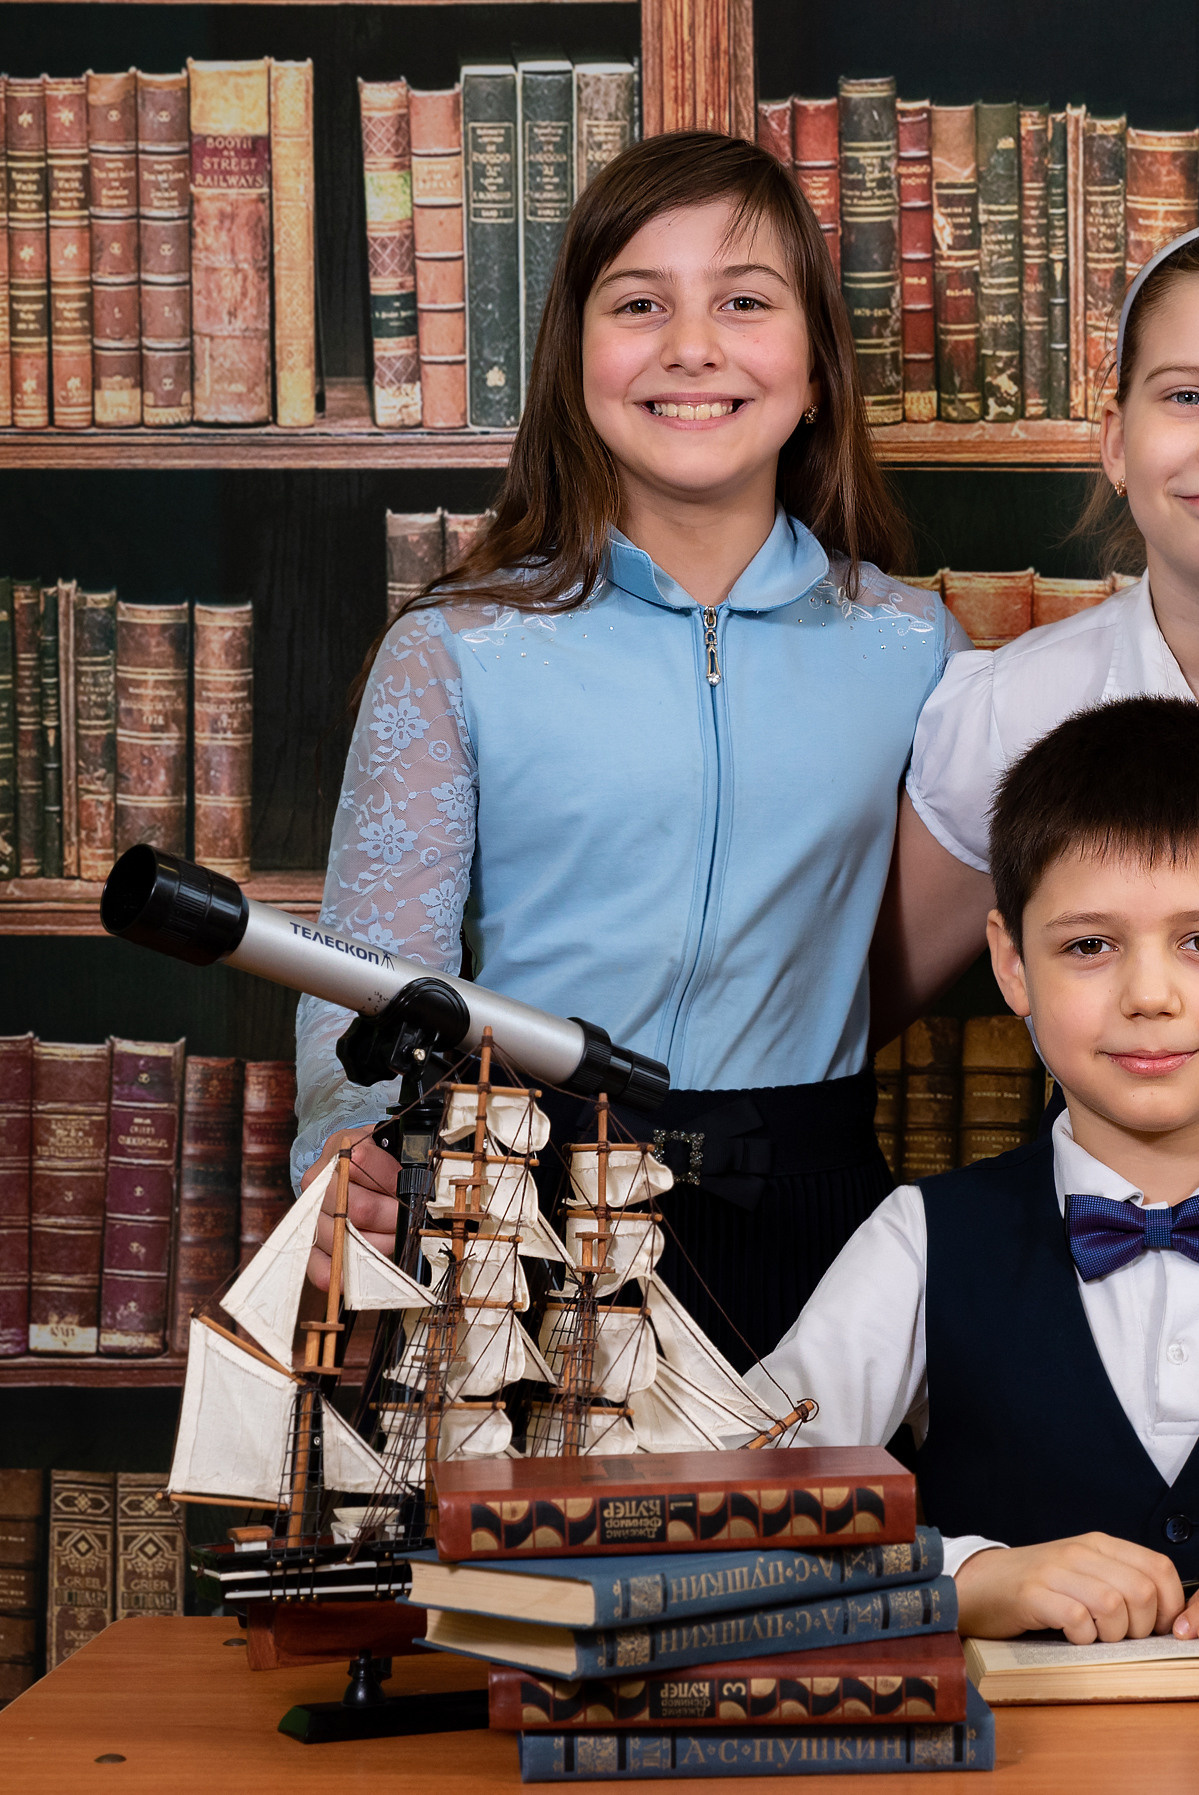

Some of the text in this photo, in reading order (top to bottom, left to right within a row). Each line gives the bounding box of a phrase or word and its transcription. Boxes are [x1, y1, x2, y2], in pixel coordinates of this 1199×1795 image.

[202, 156, 257, 171] STREET
[194, 173, 263, 187] RAILWAYS
[290, 921, 379, 965] ТЕЛЕСКОП
[603, 1499, 661, 1518] КУПЕР
[605, 1517, 662, 1528] Фенимор
[660, 1682, 710, 1698] КУПЕР
[722, 1682, 746, 1696] 3
